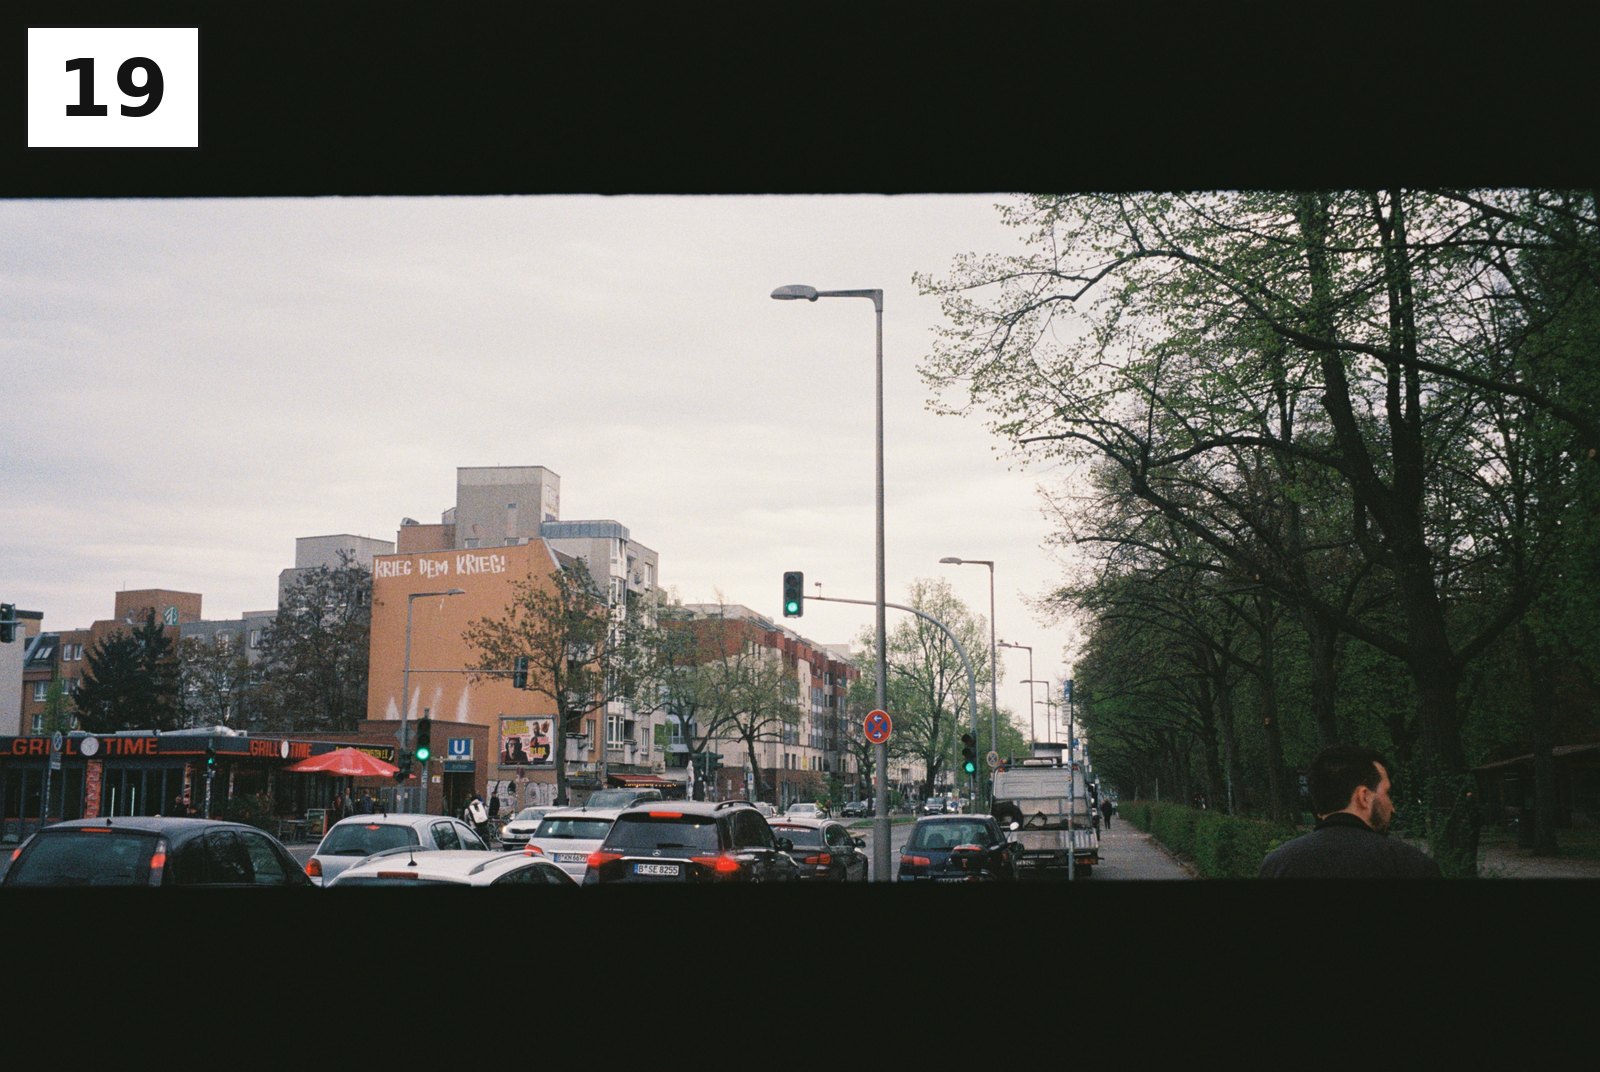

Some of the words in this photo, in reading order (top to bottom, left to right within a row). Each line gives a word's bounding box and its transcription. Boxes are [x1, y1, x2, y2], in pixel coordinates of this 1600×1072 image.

[375, 559, 411, 579] KRIEG
[419, 558, 448, 578] DEM
[456, 554, 505, 575] KRIEG!
[12, 738, 77, 755] GRIL
[104, 737, 158, 755] TIME
[250, 740, 279, 757] GRILL
[290, 742, 312, 758] TIME
[454, 740, 465, 755] U
